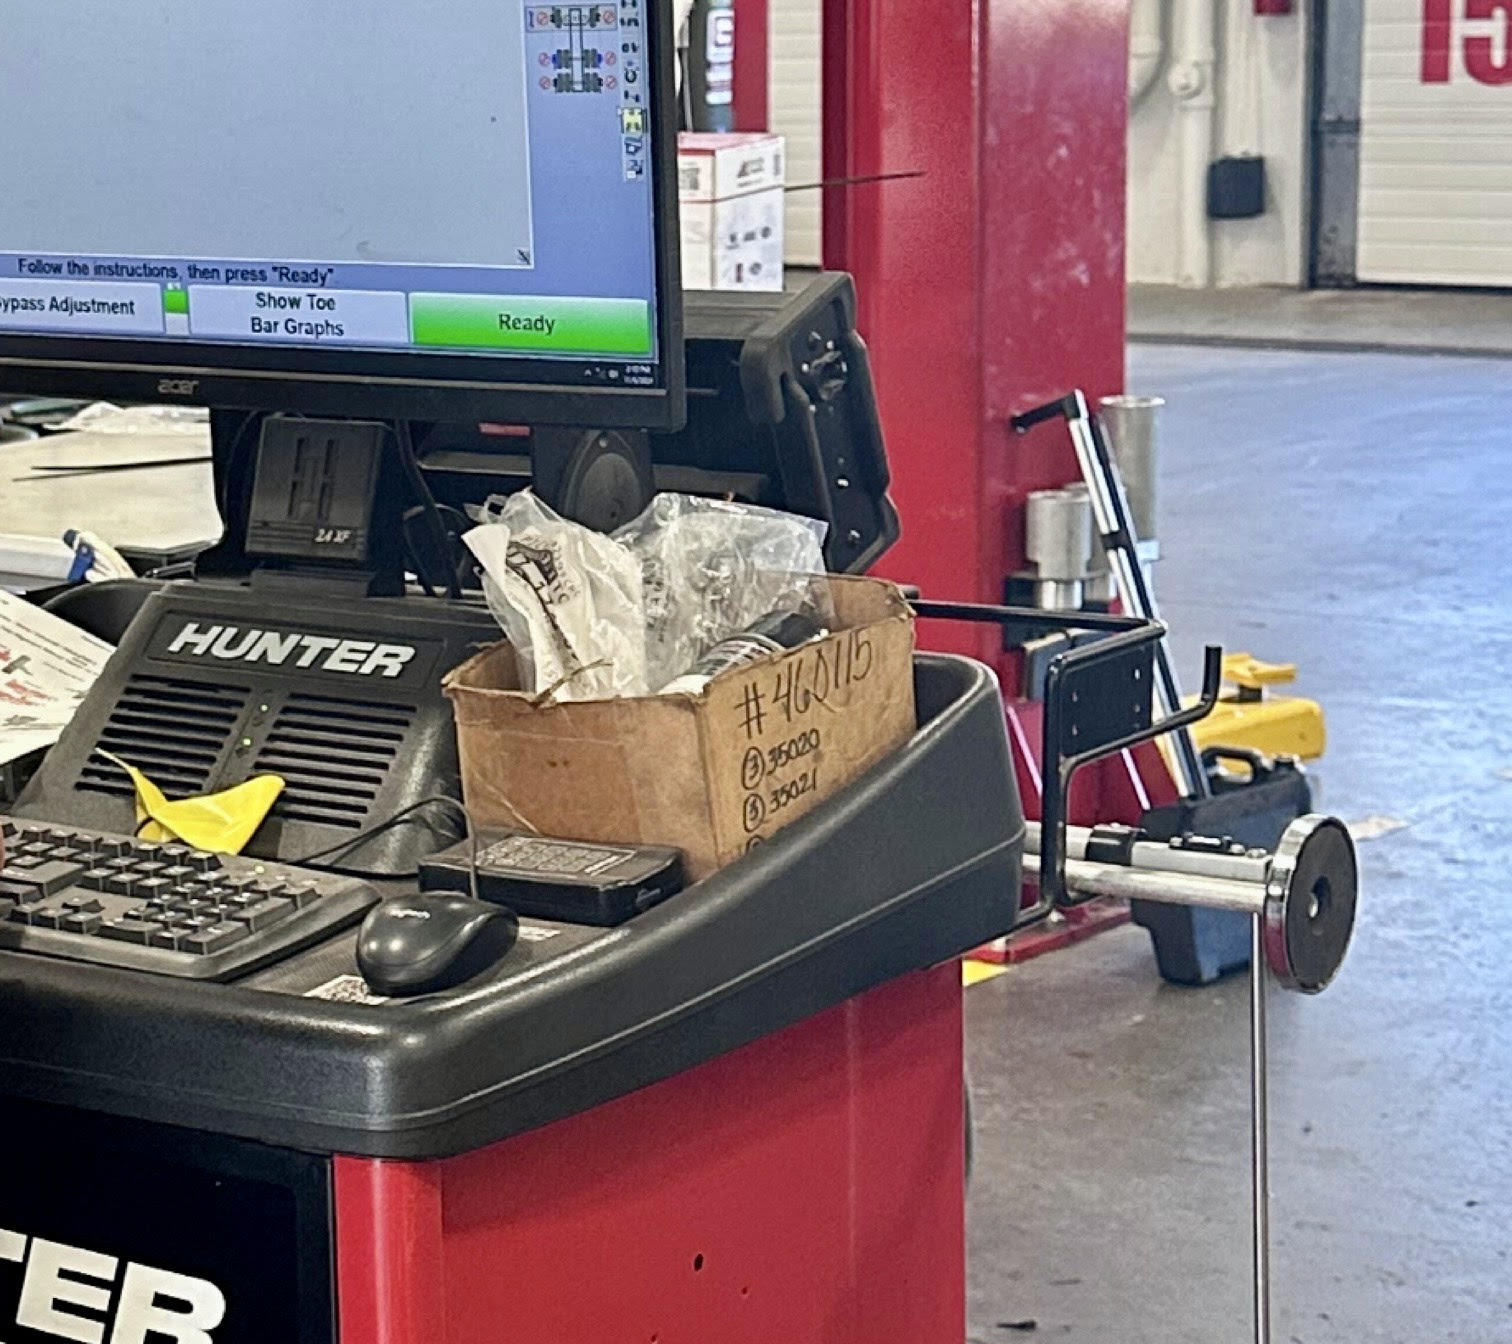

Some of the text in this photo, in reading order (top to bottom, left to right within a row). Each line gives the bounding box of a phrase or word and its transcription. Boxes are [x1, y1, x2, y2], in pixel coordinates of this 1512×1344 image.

[17, 258, 334, 286] Follow the instructions, then press "Ready"
[48, 295, 136, 316] Adjustment
[256, 291, 336, 311] Show Toe
[251, 317, 345, 340] Bar Graphs
[498, 312, 556, 336] Ready
[157, 378, 200, 396] acer
[167, 622, 416, 678] HUNTER
[766, 728, 820, 776] 35020
[769, 767, 818, 814] 35021
